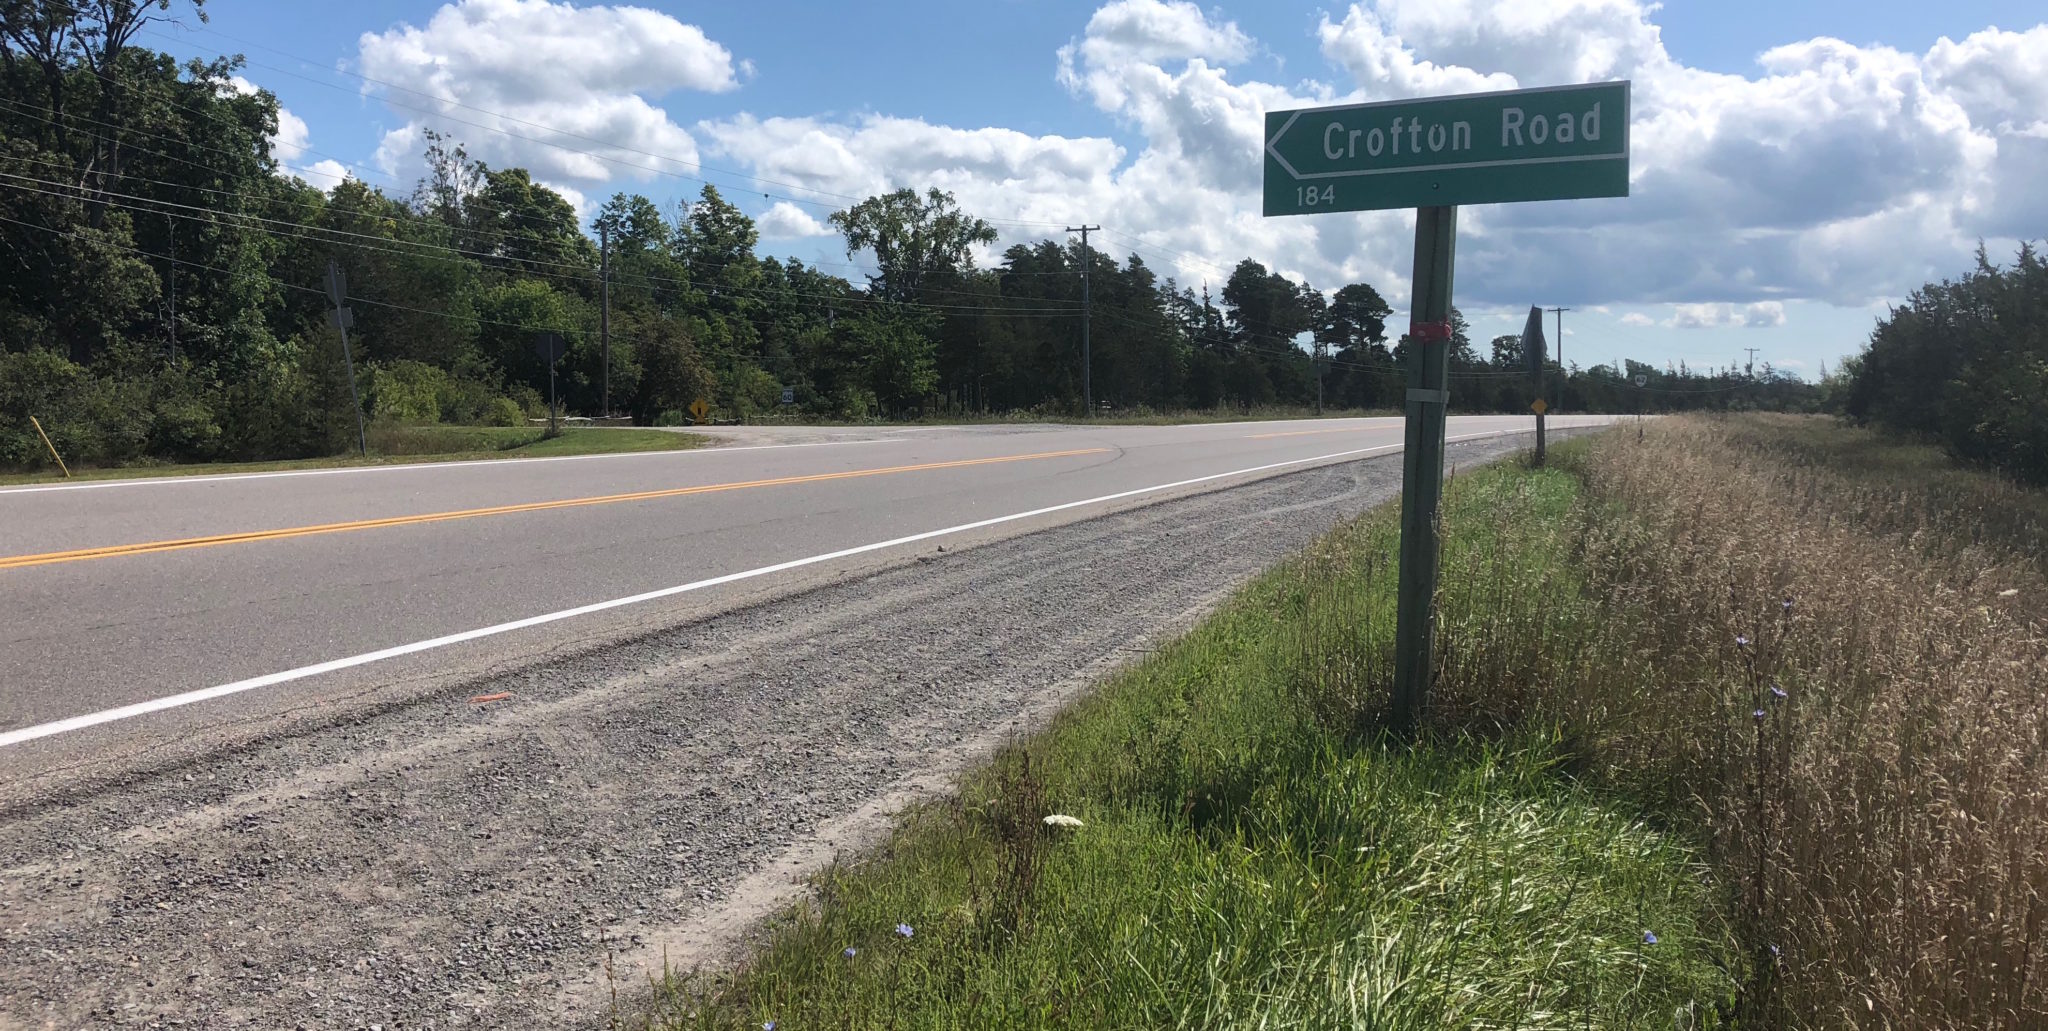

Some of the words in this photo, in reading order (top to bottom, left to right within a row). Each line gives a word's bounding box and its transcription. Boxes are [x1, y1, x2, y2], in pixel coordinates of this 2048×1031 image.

[1323, 116, 1471, 160] Crofton
[1501, 101, 1600, 147] Road
[1297, 184, 1335, 206] 184
